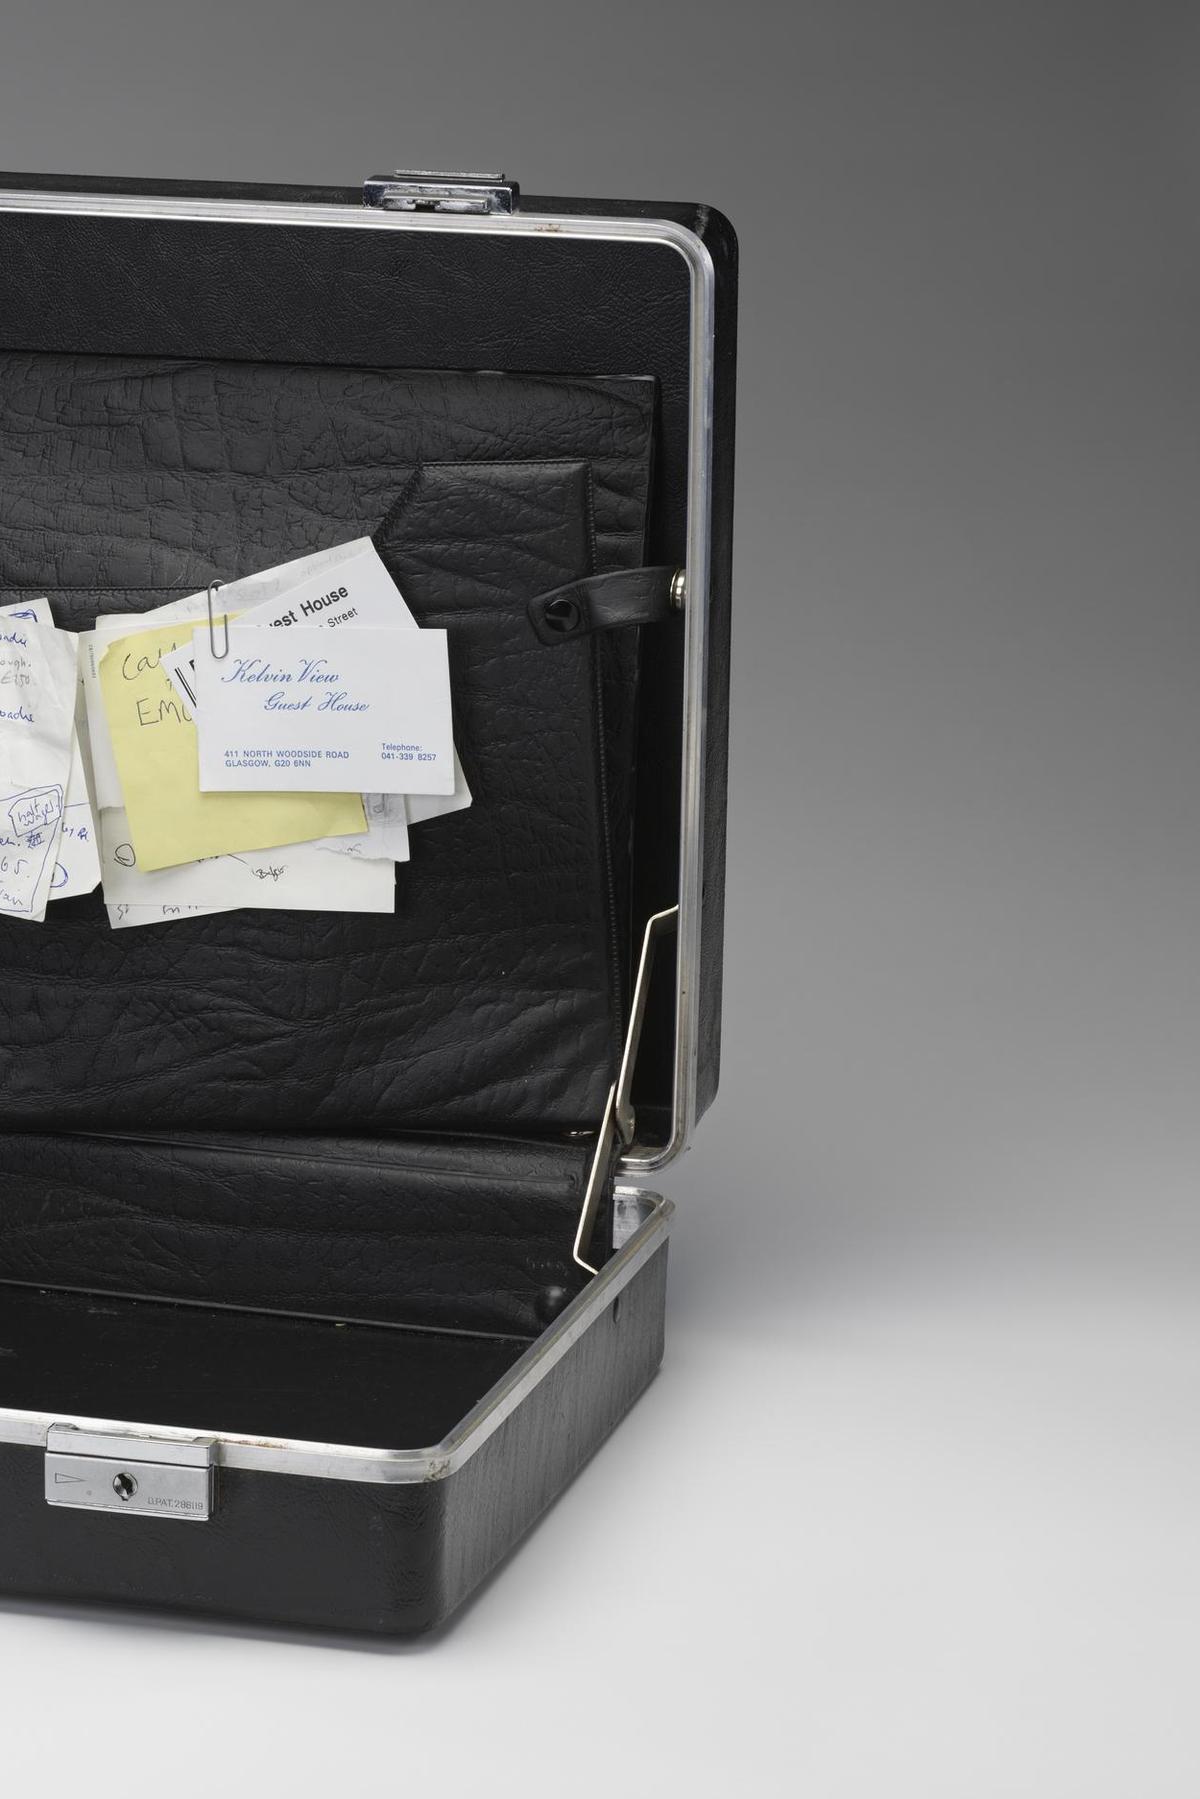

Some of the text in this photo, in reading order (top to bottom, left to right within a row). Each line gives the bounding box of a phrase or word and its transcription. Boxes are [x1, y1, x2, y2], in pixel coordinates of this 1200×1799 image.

[300, 586, 349, 617] House
[327, 607, 358, 628] Street
[221, 658, 340, 684] Kelvin View
[263, 691, 371, 712] Guest House
[224, 750, 350, 760] 411 NORTH WOODSIDE ROAD
[381, 742, 424, 753] Telephone:
[225, 760, 271, 769] GLASGOW,
[274, 760, 291, 768] G20
[381, 752, 437, 761] 041-339 8257
